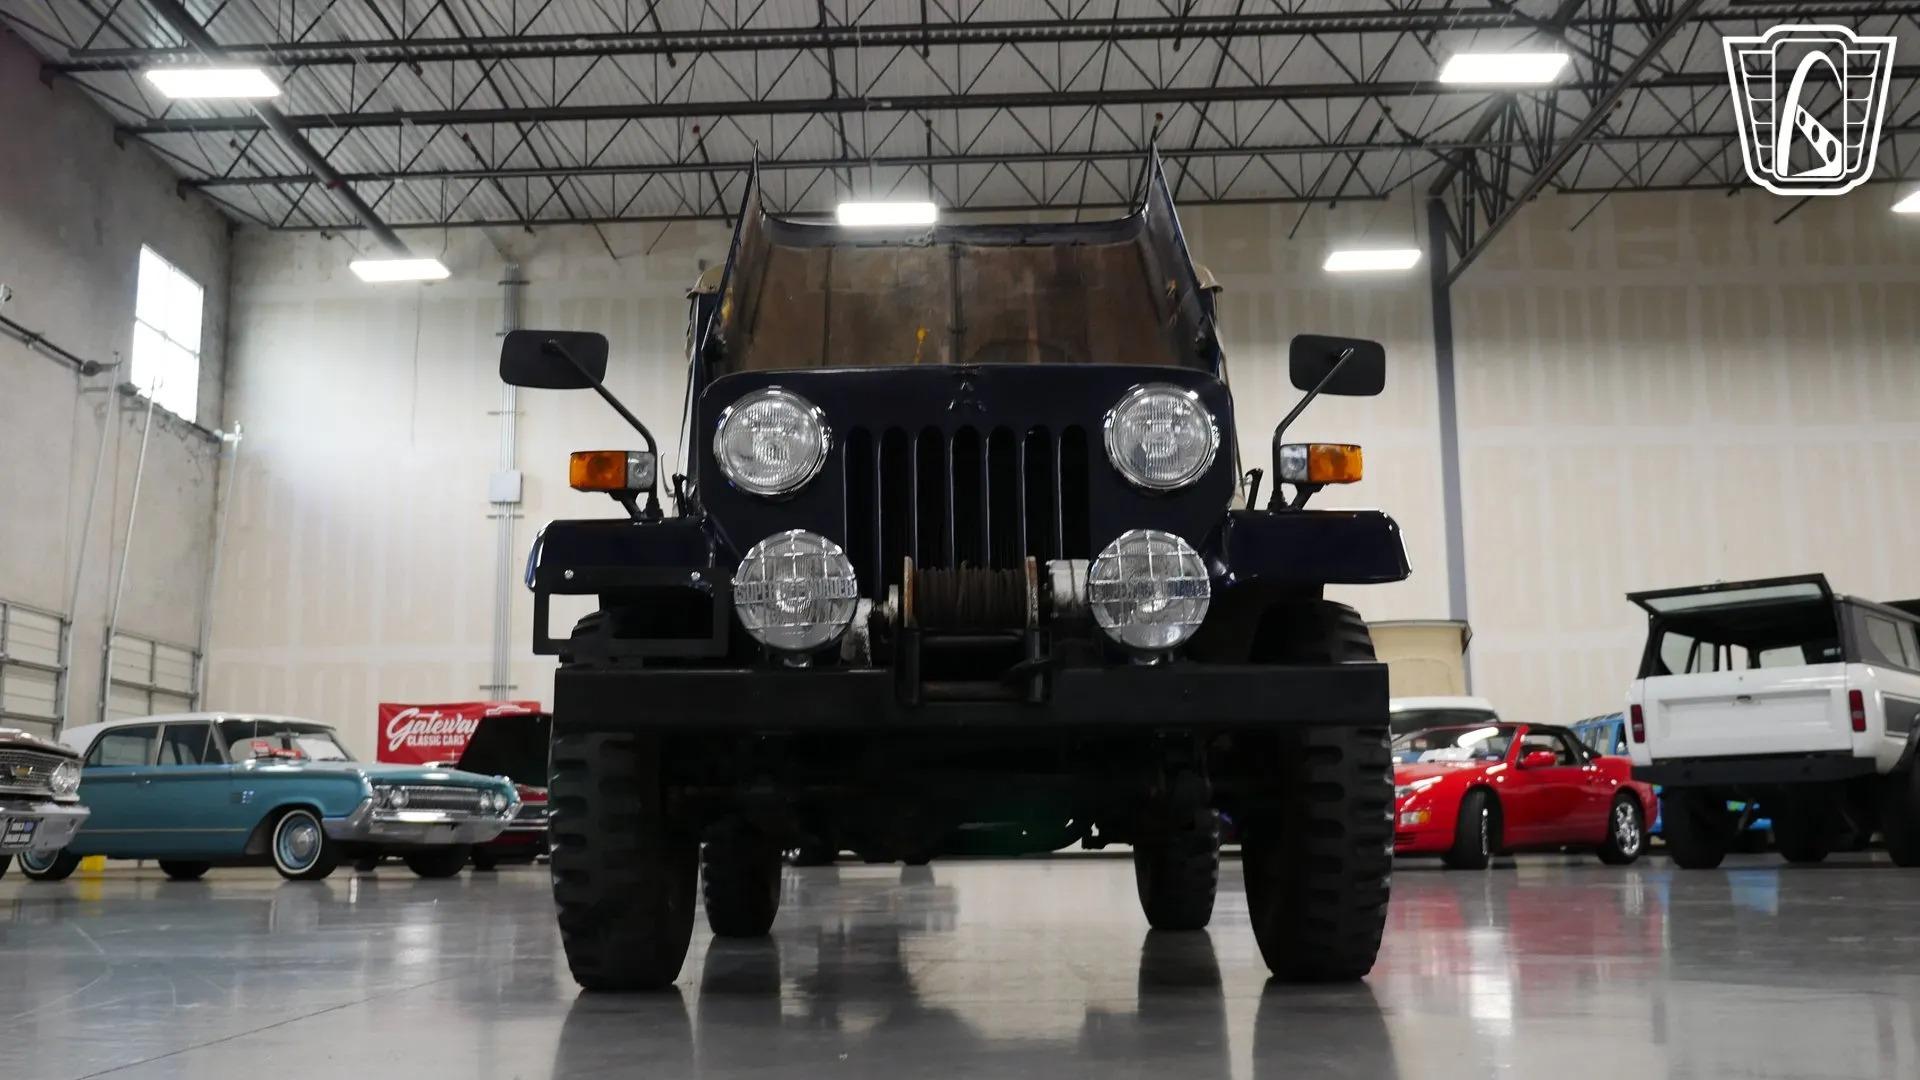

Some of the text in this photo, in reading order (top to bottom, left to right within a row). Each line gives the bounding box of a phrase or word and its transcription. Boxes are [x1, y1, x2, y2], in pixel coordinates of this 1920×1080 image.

[386, 707, 479, 751] Gateway
[407, 734, 464, 746] CLASSIC CARS
